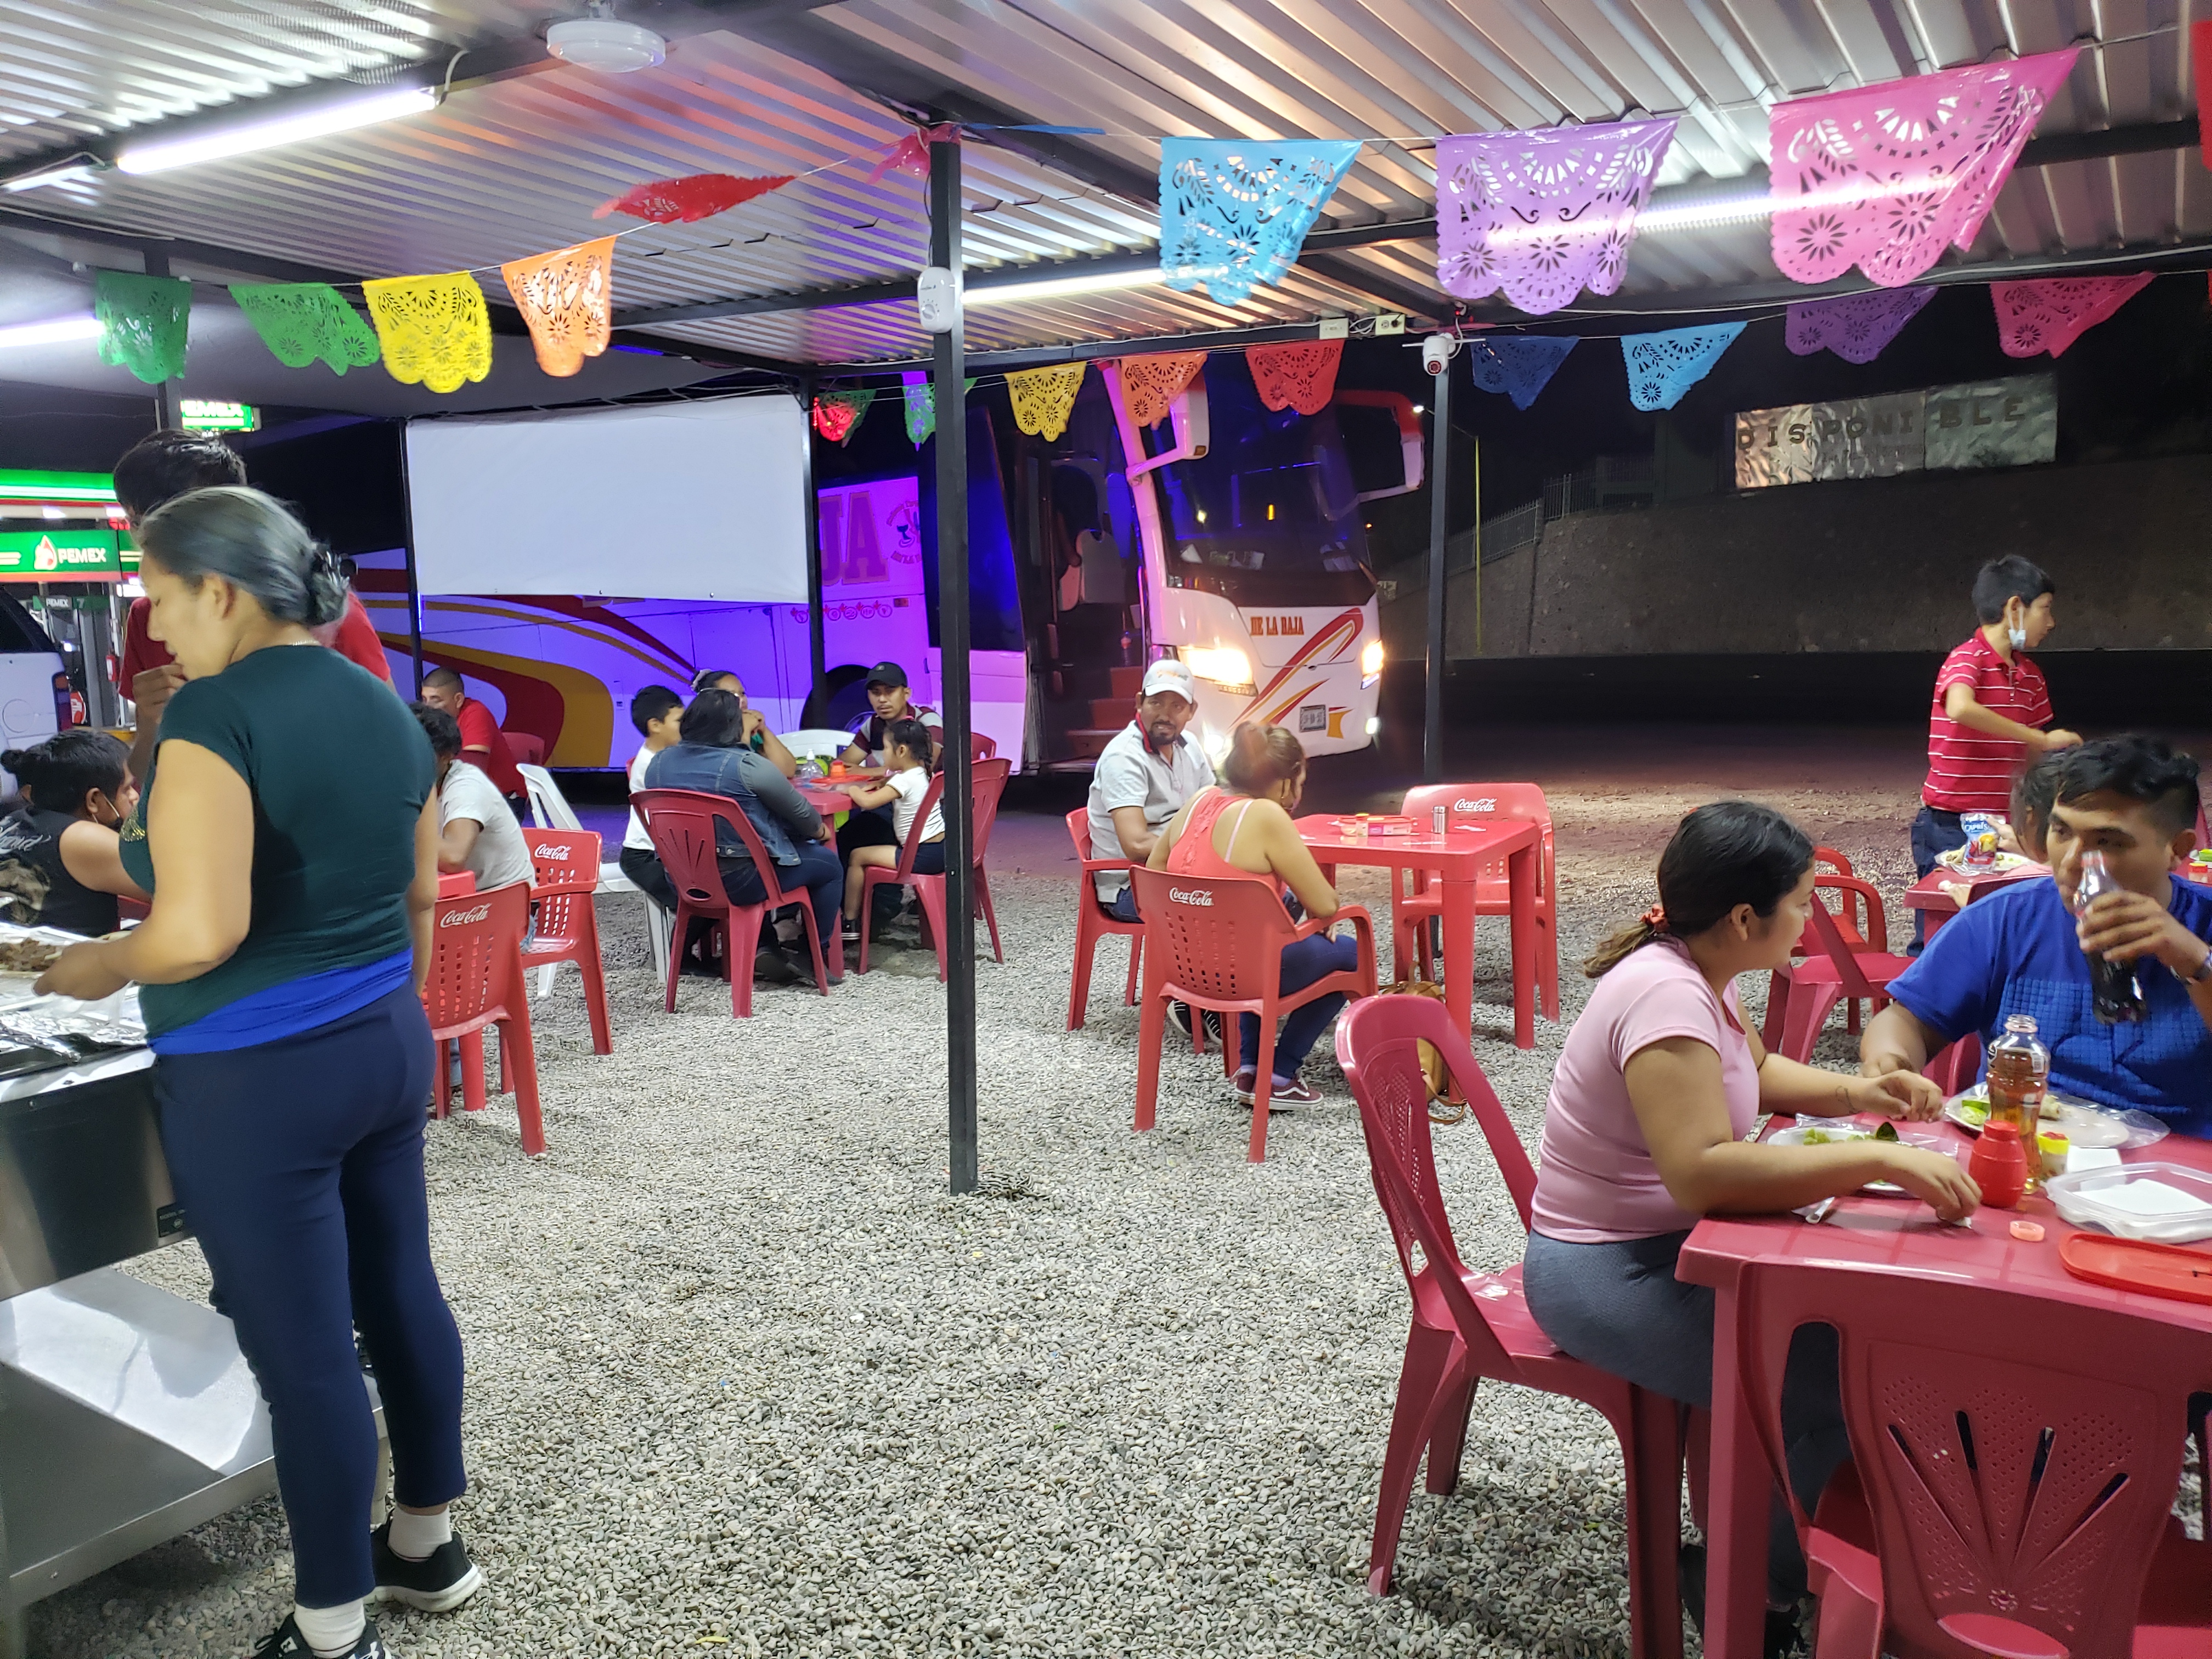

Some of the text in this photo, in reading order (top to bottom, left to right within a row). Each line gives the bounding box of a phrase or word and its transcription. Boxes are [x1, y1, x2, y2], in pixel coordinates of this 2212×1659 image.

[180, 400, 244, 417] EMEX
[57, 547, 106, 564] PEMEX
[46, 597, 69, 608] PEMEX
[1266, 616, 1278, 635] LA
[1454, 798, 1497, 812] Coca-Cola
[534, 843, 572, 861] Coca-Cola
[1169, 887, 1214, 906] Coca-Cola
[440, 903, 492, 928] Coca-Cola
